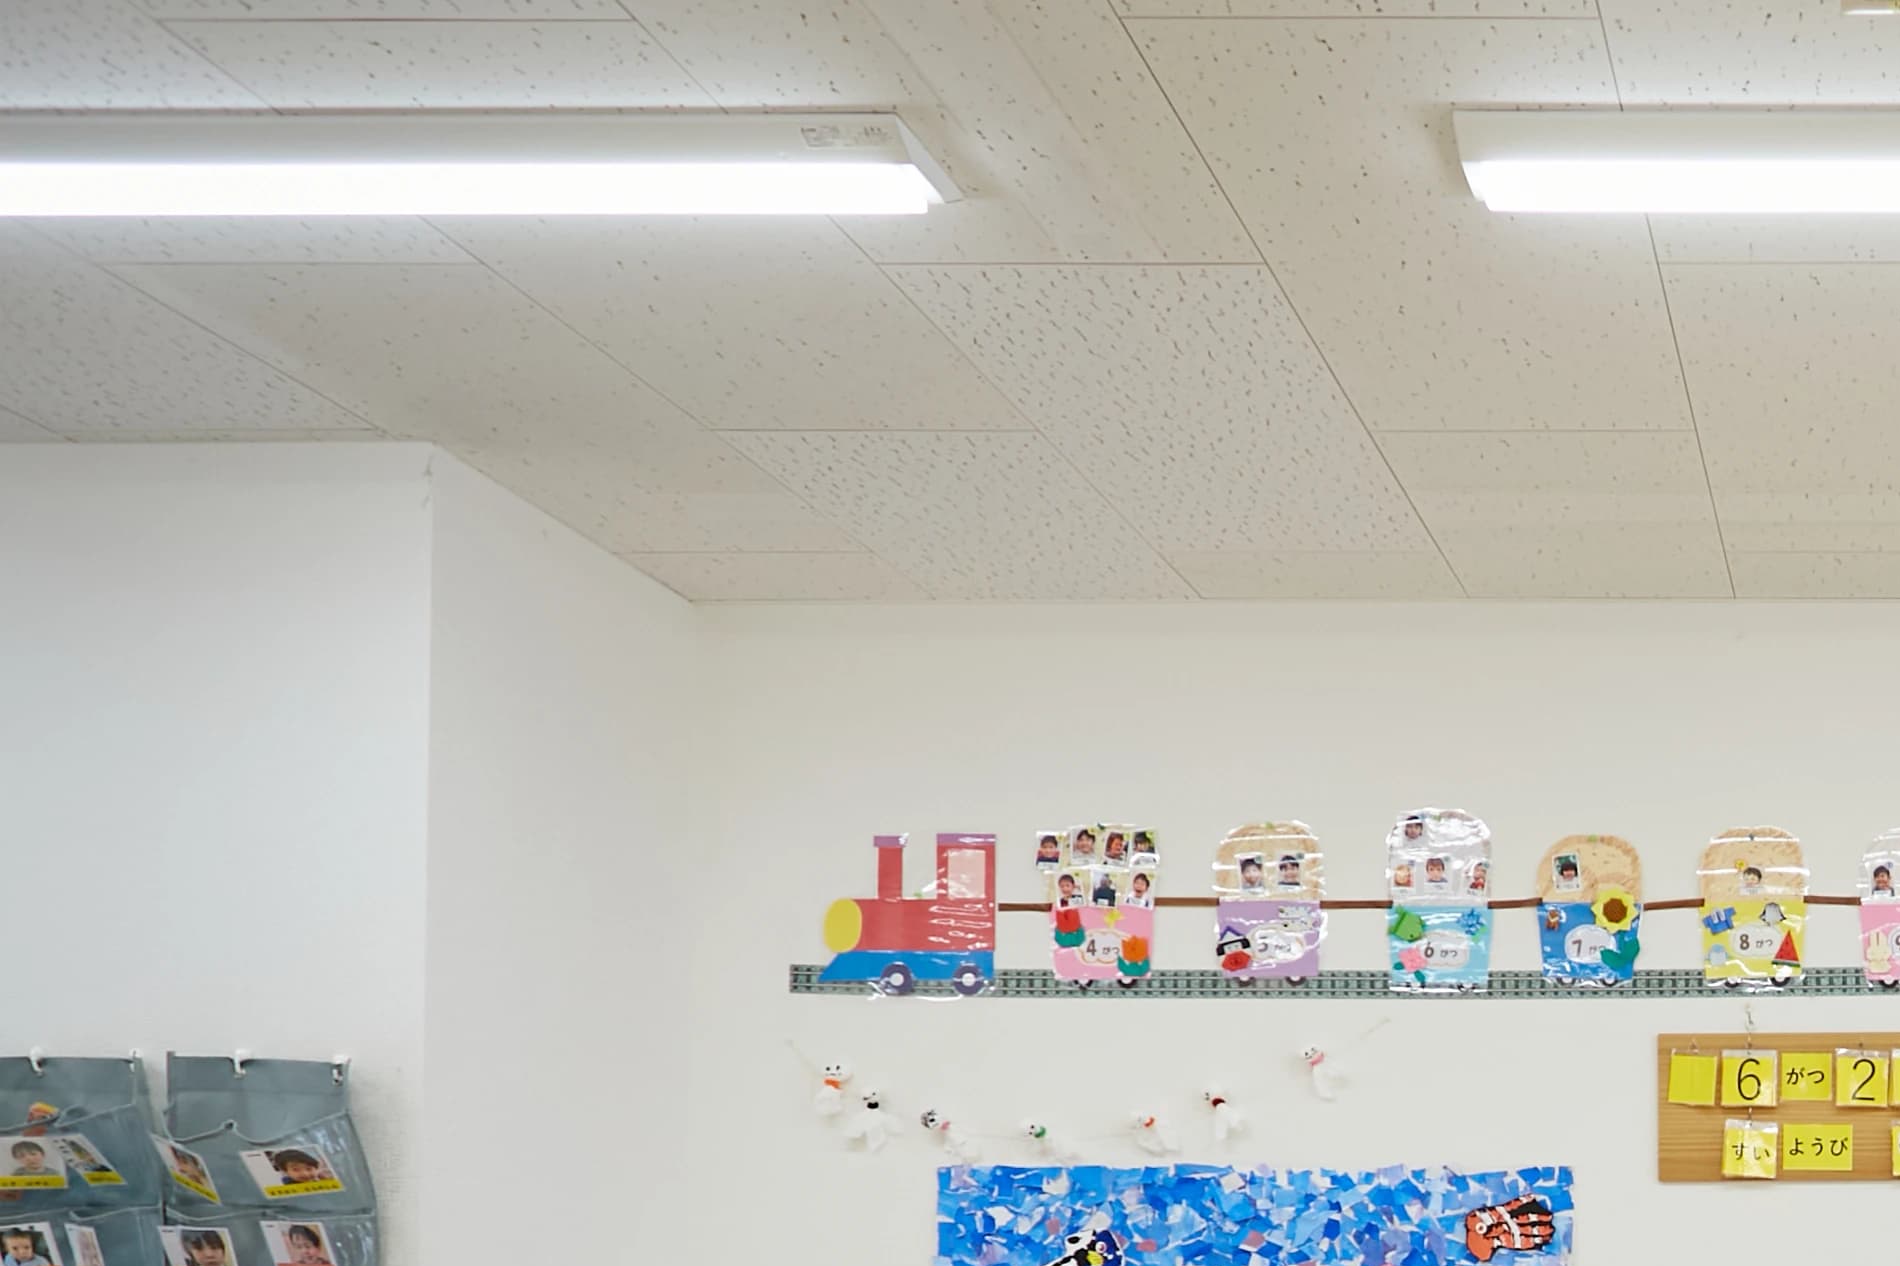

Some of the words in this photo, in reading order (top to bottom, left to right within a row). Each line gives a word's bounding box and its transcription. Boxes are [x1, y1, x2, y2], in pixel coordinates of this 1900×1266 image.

[1086, 939, 1096, 956] 4
[1424, 941, 1434, 958] 6
[1571, 939, 1582, 957] 7
[1740, 934, 1750, 950] 8
[1755, 939, 1773, 948] がつ
[1737, 1057, 1762, 1101] 6
[1786, 1066, 1826, 1086] がつ
[1852, 1058, 1876, 1102] 2
[1731, 1142, 1771, 1161] すい
[1788, 1137, 1849, 1157] ようび
